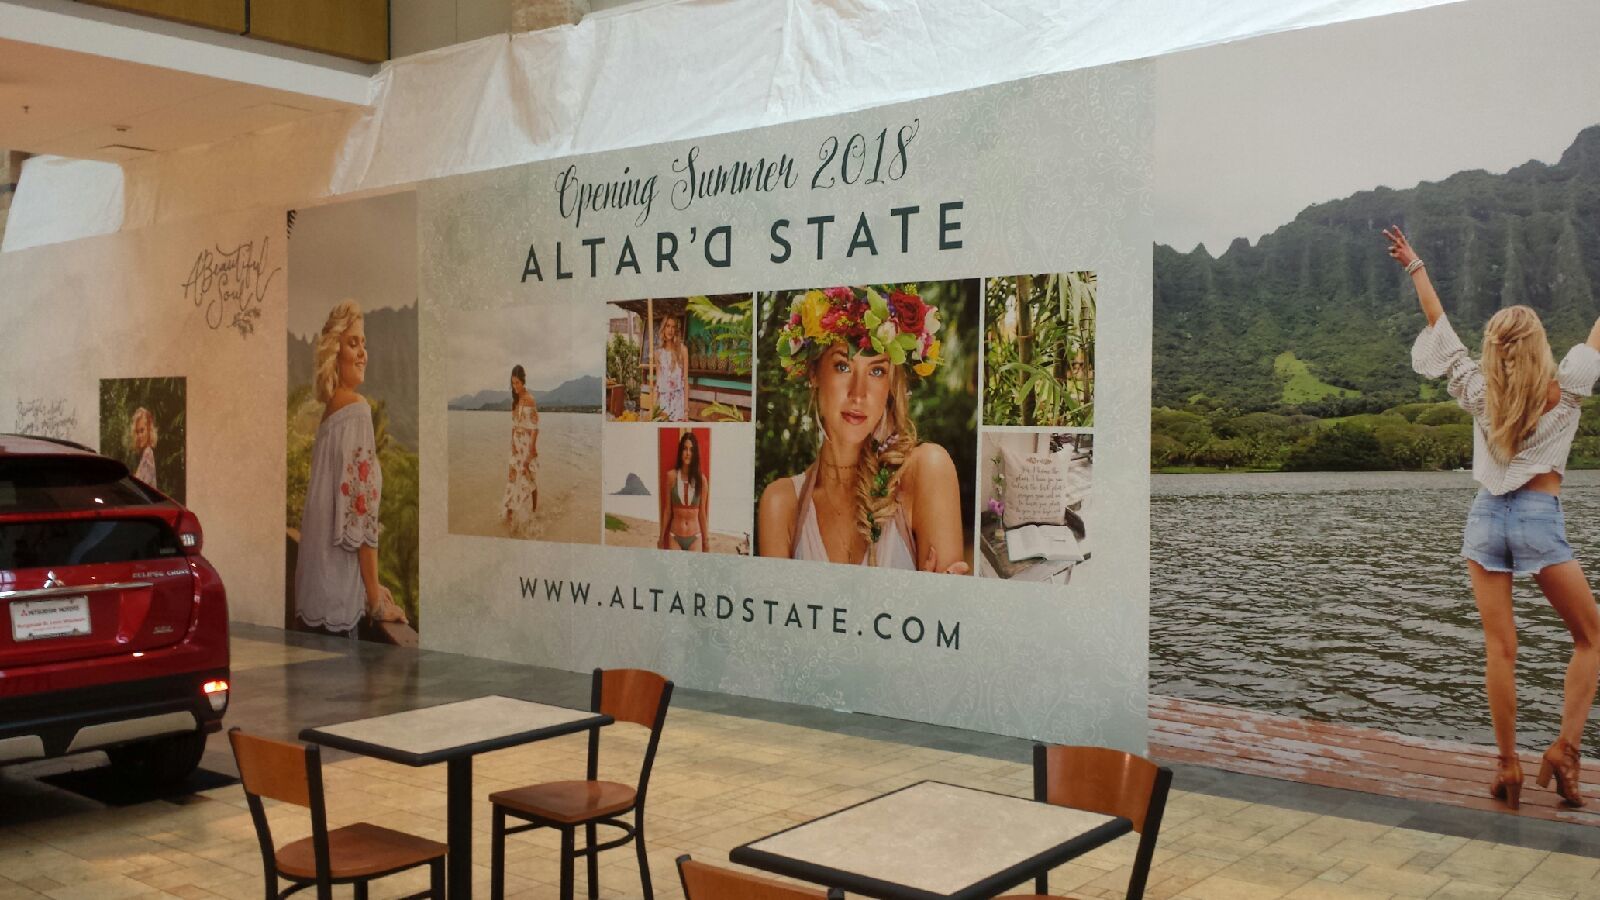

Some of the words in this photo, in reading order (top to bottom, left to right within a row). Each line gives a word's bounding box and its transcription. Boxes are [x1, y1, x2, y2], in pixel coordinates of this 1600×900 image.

[555, 164, 660, 228] Opening
[671, 145, 799, 211] Summer
[810, 117, 920, 190] 2018
[769, 201, 964, 264] STATE
[201, 235, 282, 303] Beautiful
[206, 273, 254, 330] Soul
[519, 576, 962, 650] WWW.ALTARDSTATE.COM
